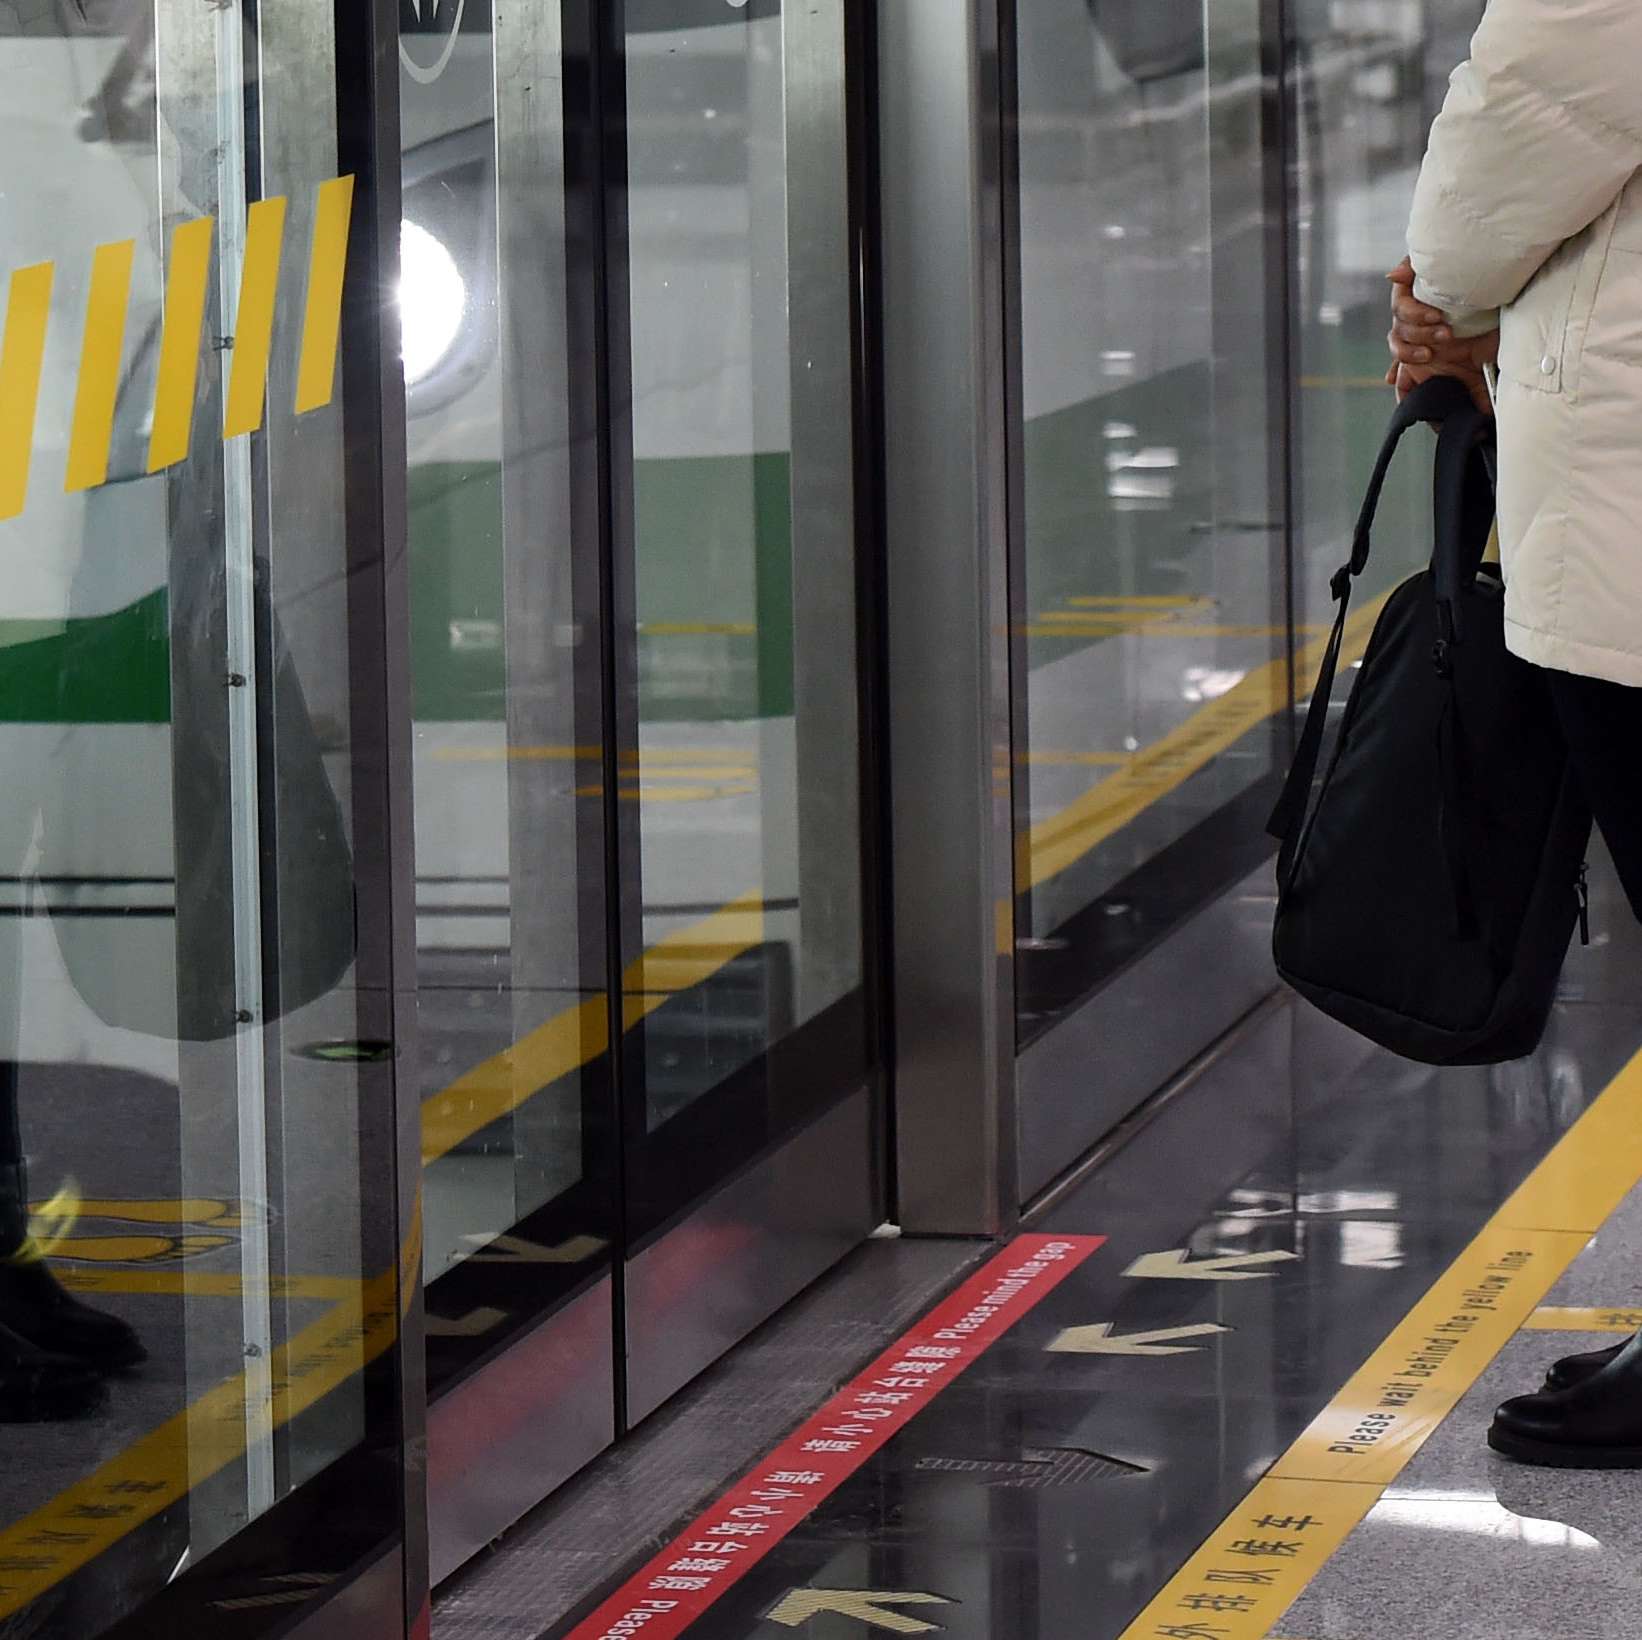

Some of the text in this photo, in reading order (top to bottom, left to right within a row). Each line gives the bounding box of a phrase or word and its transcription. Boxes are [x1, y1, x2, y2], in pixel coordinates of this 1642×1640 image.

[932, 1305, 999, 1340] Please
[981, 1278, 1030, 1305] mind
[1007, 1261, 1050, 1278] the
[1032, 1241, 1077, 1261] gap
[1326, 1251, 1533, 1455] Please wait behind the yellow line
